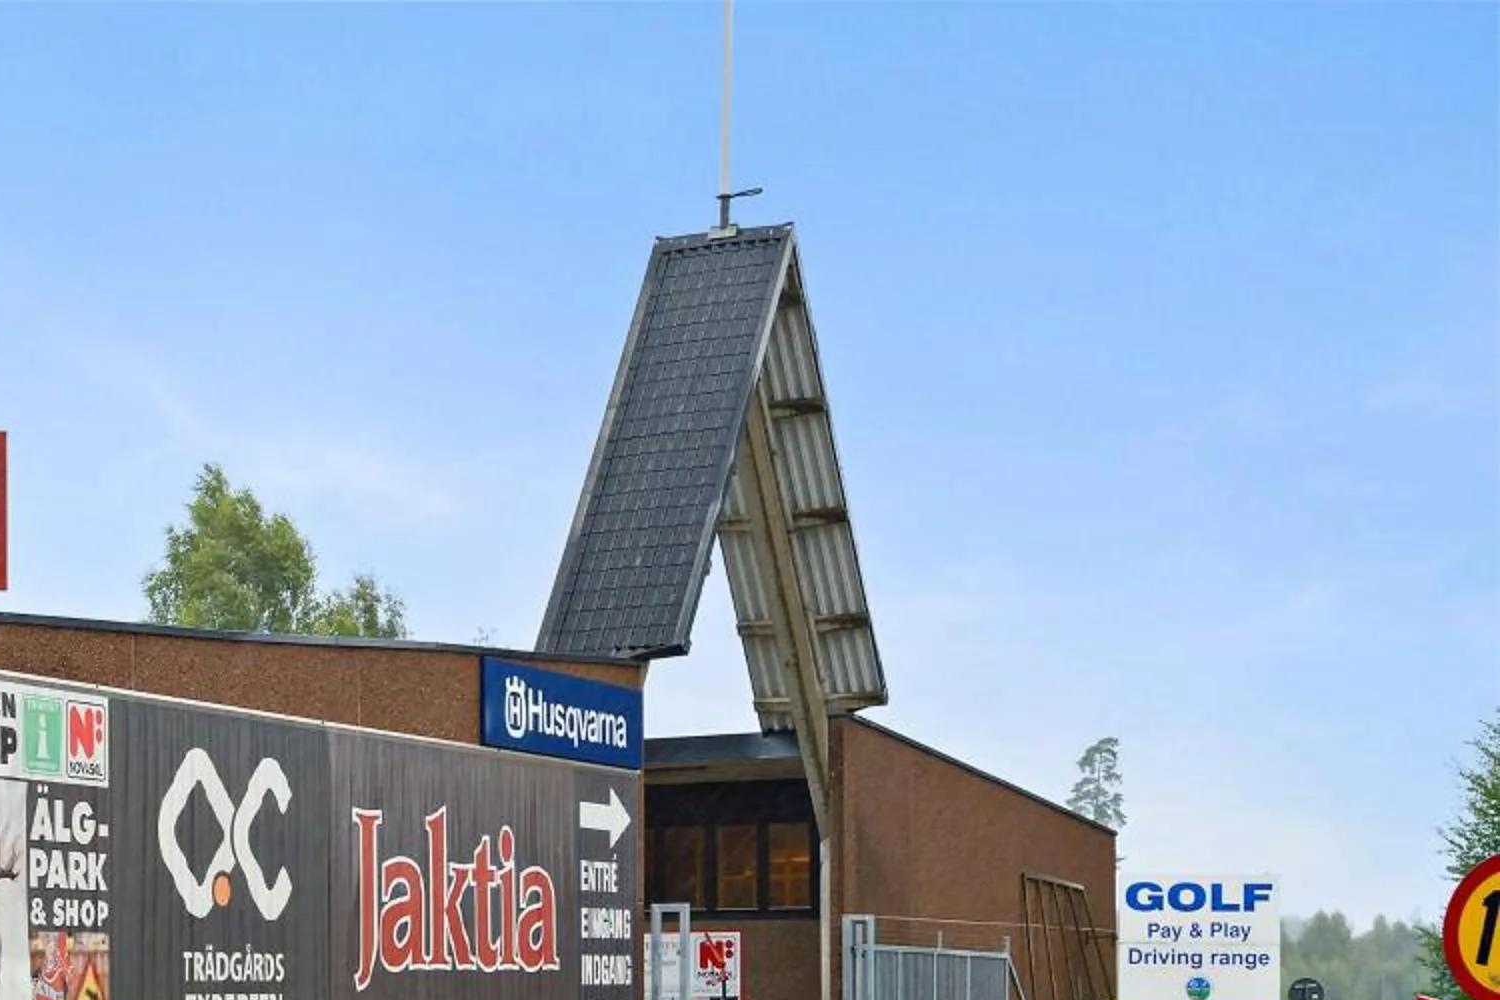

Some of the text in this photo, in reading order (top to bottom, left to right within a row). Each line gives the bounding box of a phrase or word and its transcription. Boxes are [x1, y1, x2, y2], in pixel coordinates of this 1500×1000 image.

[528, 688, 627, 748] Husqvarna
[29, 848, 108, 891] PARK
[580, 853, 618, 892] ENTRÉ
[30, 898, 109, 927] & SHOP
[352, 806, 559, 991] Jaktia
[1125, 882, 1273, 912] GOLF
[581, 908, 631, 939] EINGANG
[1147, 922, 1251, 943] Pay & Play
[184, 945, 285, 982] TRÄDGÅRDS
[581, 954, 632, 986] INDGANG
[1128, 948, 1270, 970] Driving range
